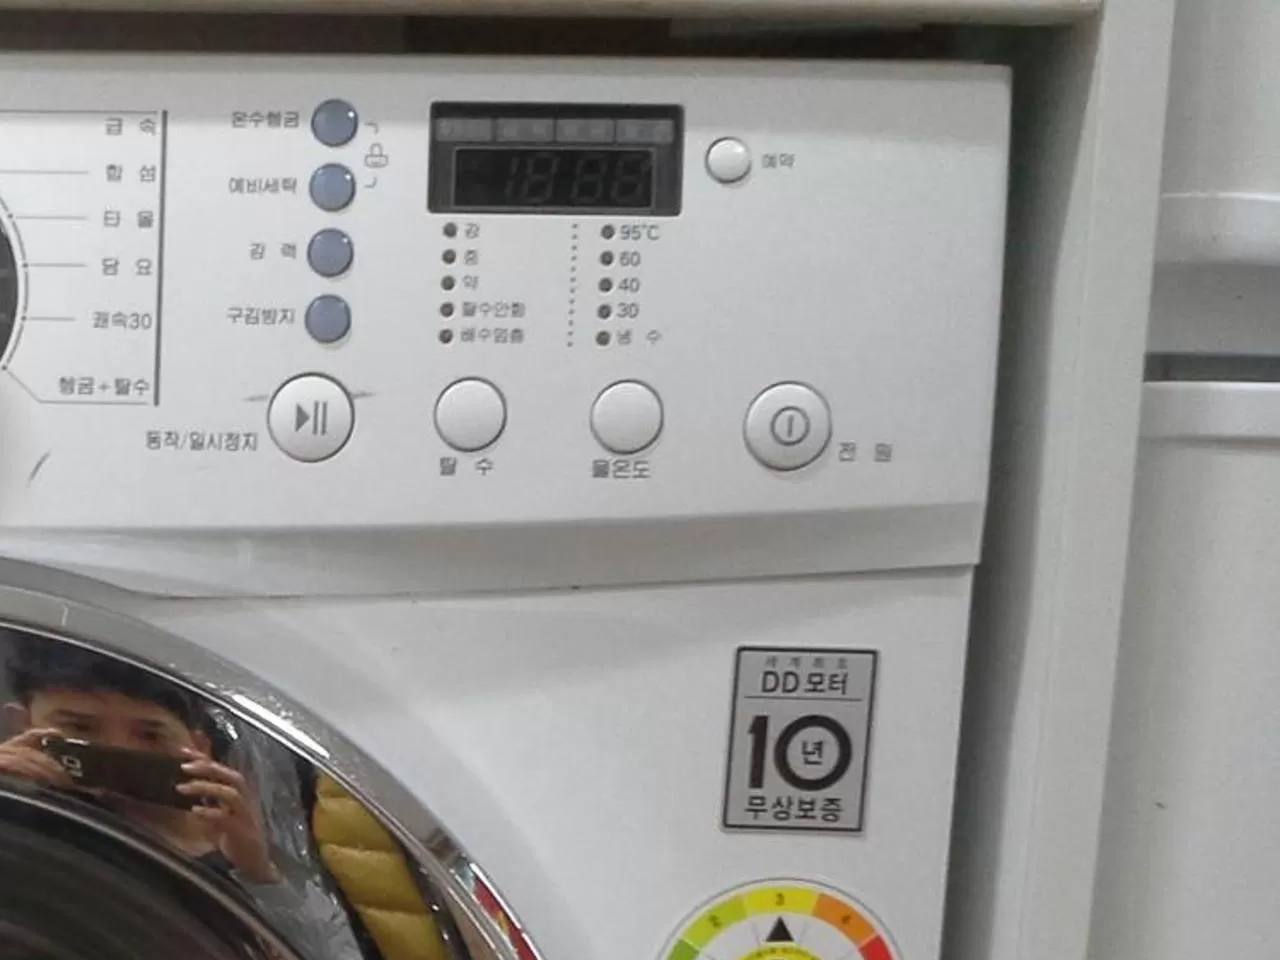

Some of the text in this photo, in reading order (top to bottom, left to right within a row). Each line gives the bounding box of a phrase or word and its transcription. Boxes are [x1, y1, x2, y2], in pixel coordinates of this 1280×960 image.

[228, 176, 297, 195] 예비세탁
[620, 250, 641, 267] 60
[618, 277, 640, 294] 40
[226, 306, 297, 326] 구김방지
[617, 302, 640, 319] 30
[748, 714, 852, 791] 10 년
[745, 795, 843, 822] 무상보증
